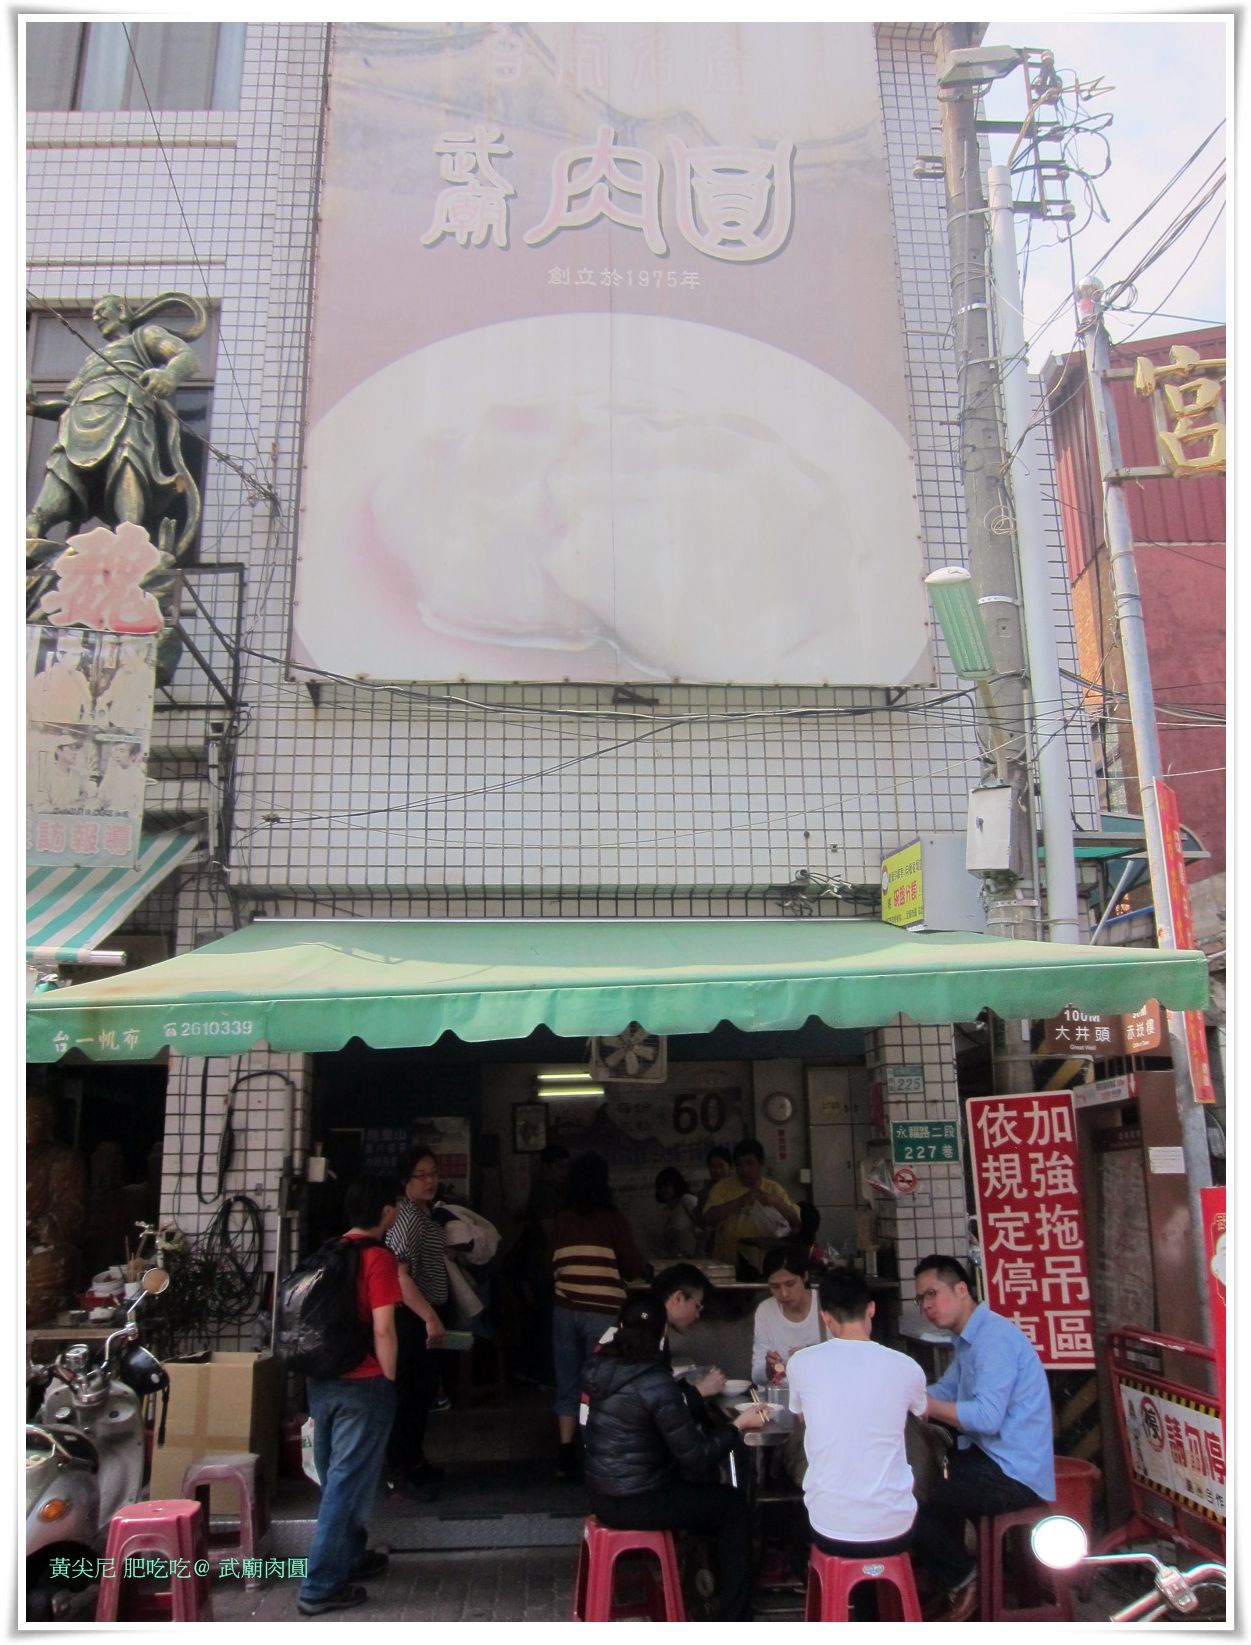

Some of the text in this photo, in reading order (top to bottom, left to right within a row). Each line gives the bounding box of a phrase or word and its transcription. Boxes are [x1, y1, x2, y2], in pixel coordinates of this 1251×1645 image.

[421, 126, 799, 263] 武廟 肉圓
[546, 267, 702, 290] 創立於1975年
[26, 820, 133, 857] 訪報導
[52, 1028, 141, 1053] 台一帆布
[181, 1020, 254, 1037] 2610339
[1054, 1025, 1111, 1043] 大井頭
[896, 1078, 921, 1091] 225
[673, 1093, 726, 1134] 60
[904, 1143, 955, 1160] 227巷
[1027, 1103, 1096, 1360] 加強拖吊區
